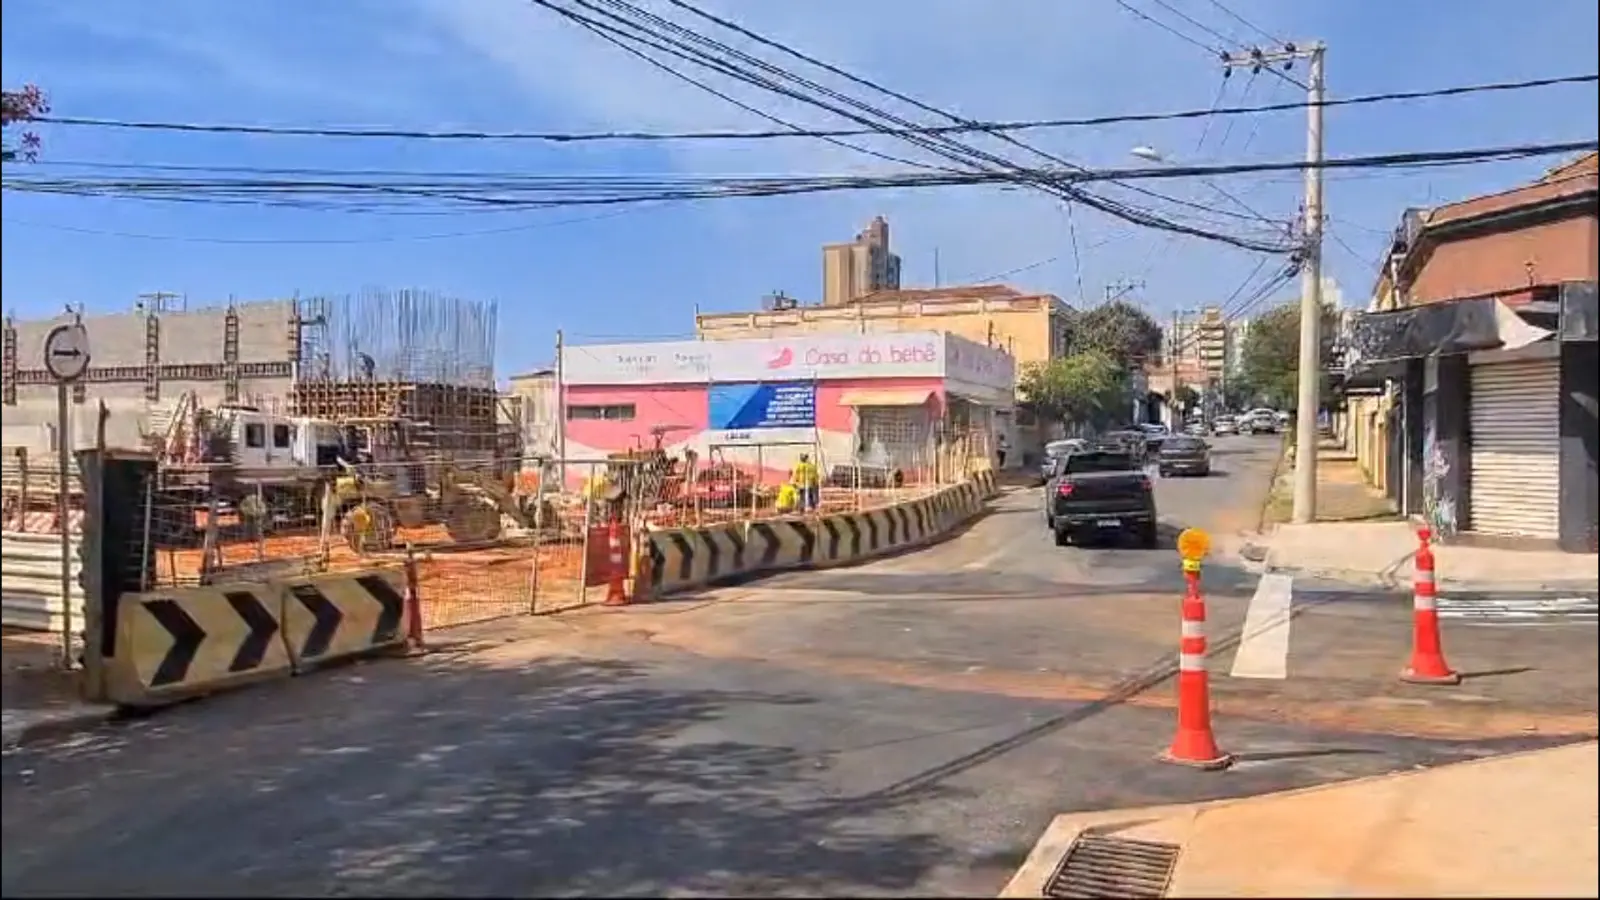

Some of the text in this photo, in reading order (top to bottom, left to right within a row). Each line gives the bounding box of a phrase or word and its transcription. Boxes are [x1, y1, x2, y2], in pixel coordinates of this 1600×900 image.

[806, 349, 848, 366] Casa
[858, 346, 881, 365] do
[891, 343, 936, 364] bebê
